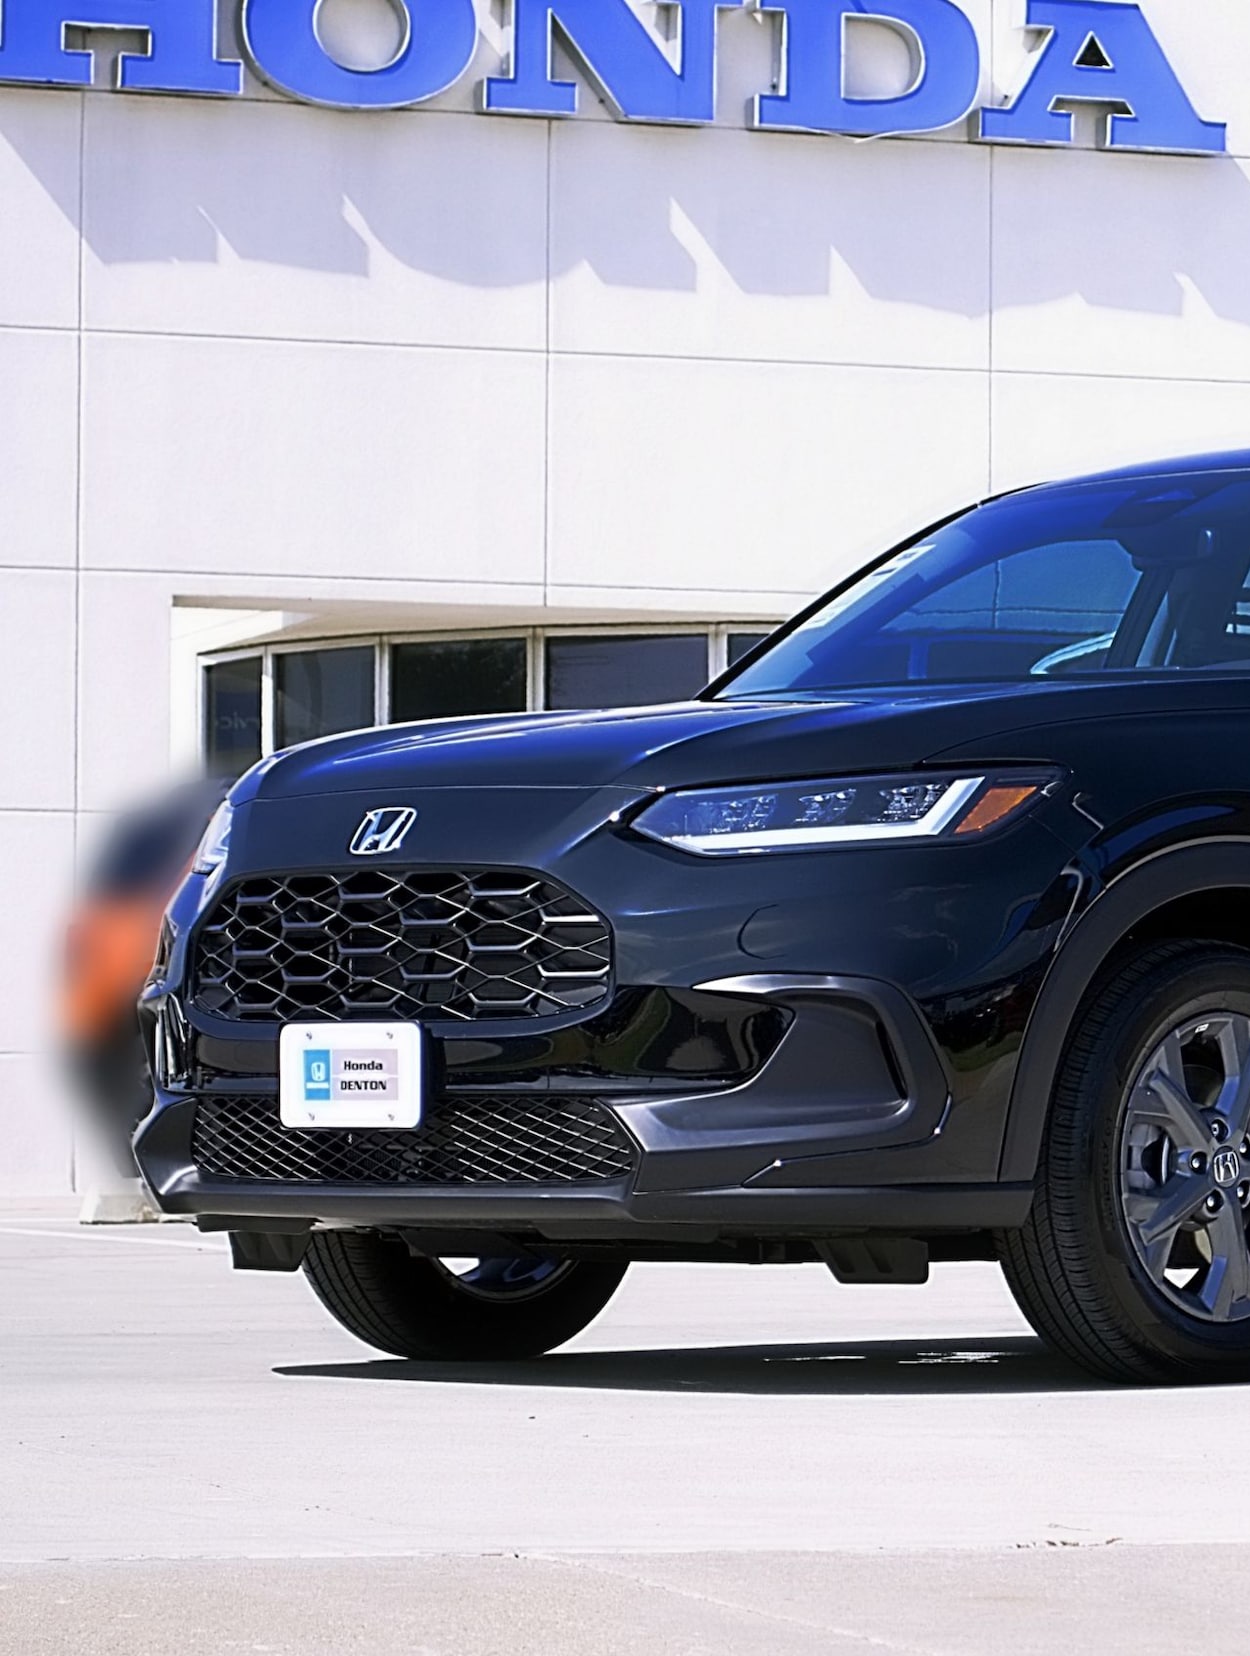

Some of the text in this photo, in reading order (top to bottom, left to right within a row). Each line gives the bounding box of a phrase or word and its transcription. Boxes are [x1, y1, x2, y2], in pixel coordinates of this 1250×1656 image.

[0, 0, 1227, 154] HONDA
[344, 1060, 383, 1070] Honda
[340, 1080, 387, 1090] DENTON
